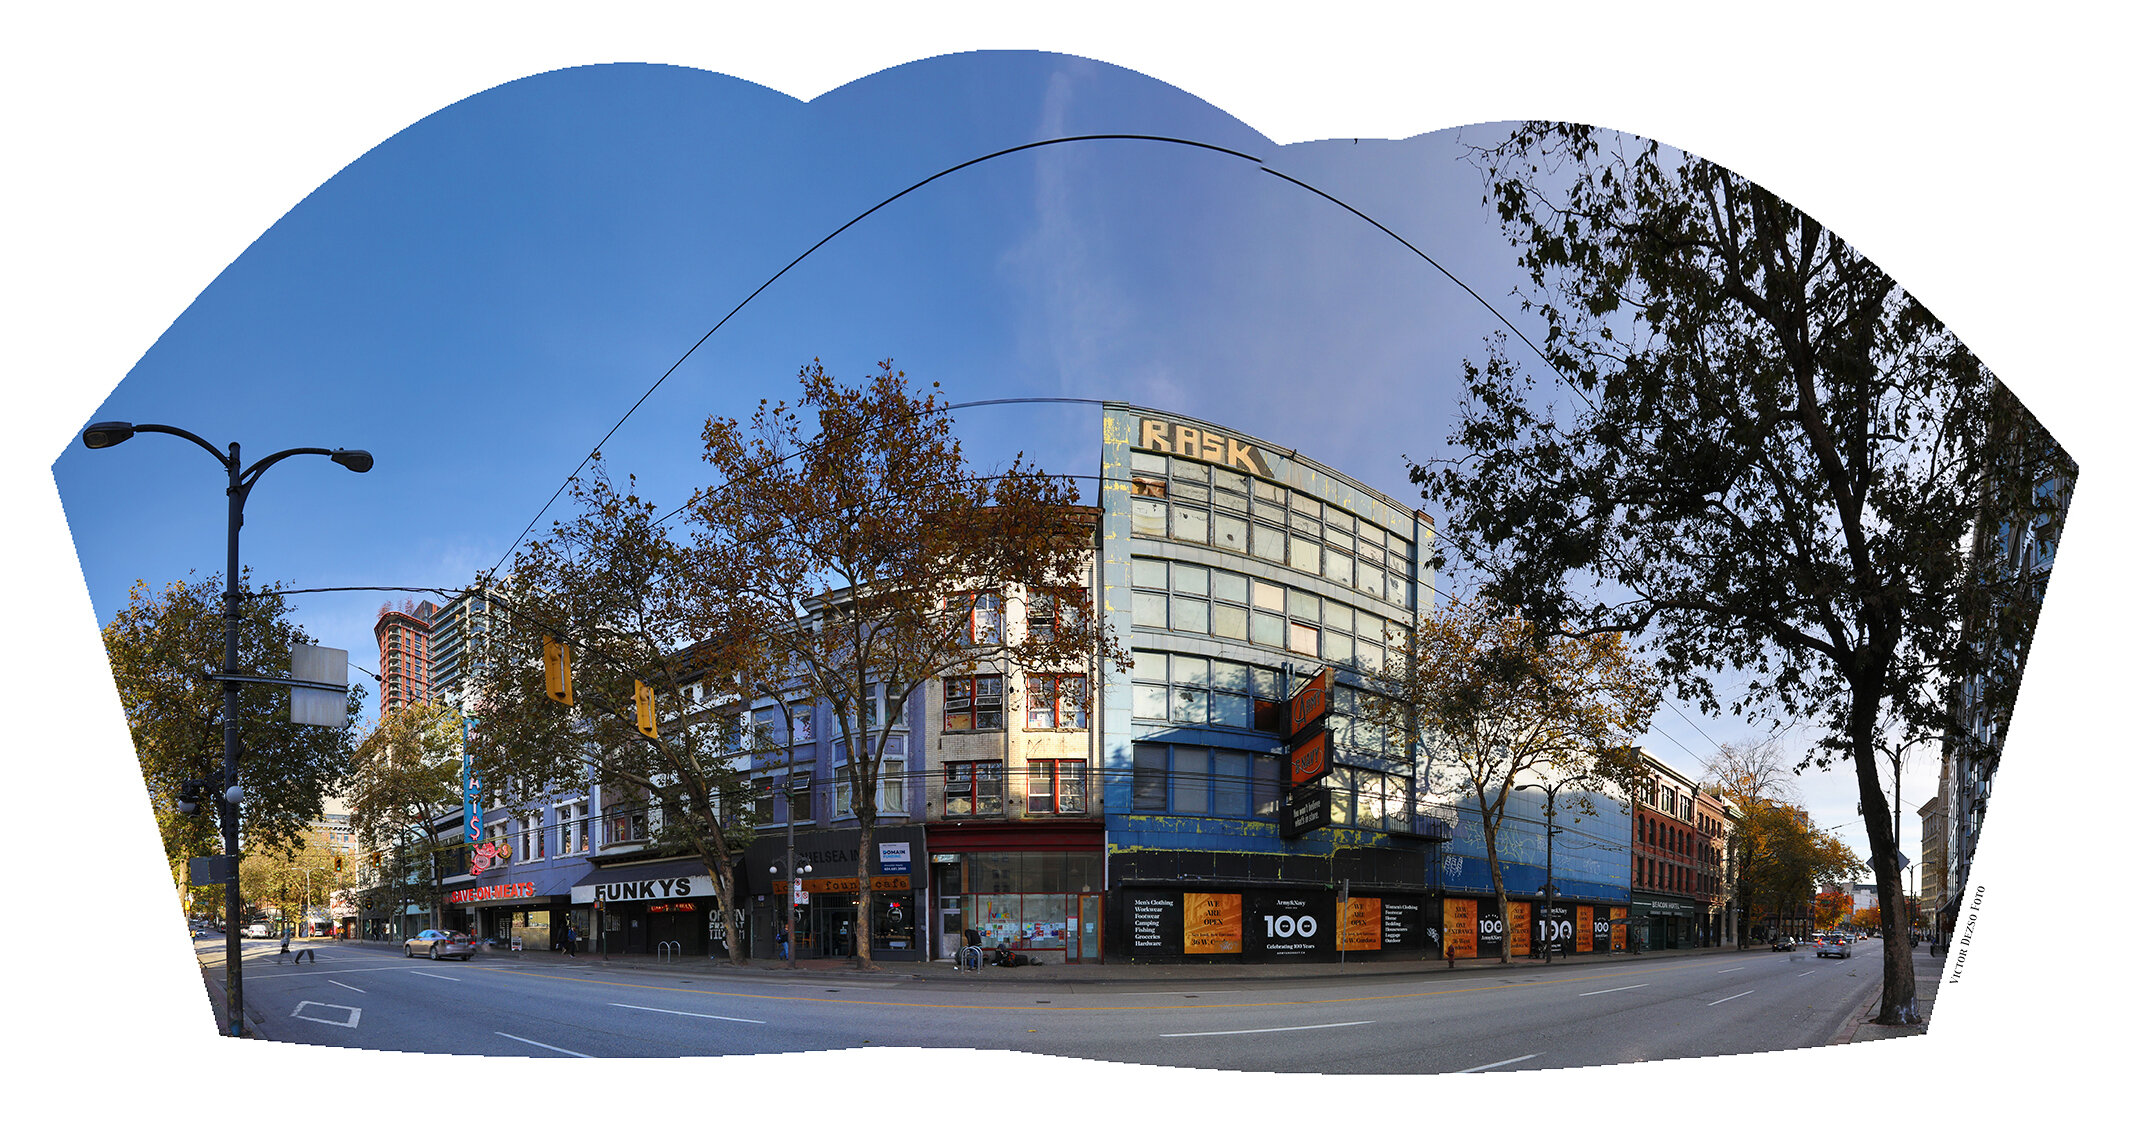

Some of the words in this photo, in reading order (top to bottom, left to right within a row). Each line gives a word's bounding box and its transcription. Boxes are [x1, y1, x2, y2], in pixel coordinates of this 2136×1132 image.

[1141, 417, 1265, 476] RASK
[451, 881, 535, 904] SAVE-ON-MEATS
[595, 877, 691, 900] FUNKYS
[826, 881, 859, 891] foun
[875, 877, 907, 889] cafe
[1203, 918, 1224, 926] OPEN
[1264, 915, 1318, 938] 100
[1480, 920, 1503, 934] 100
[1539, 920, 1573, 941] 100
[1594, 922, 1610, 933] 100
